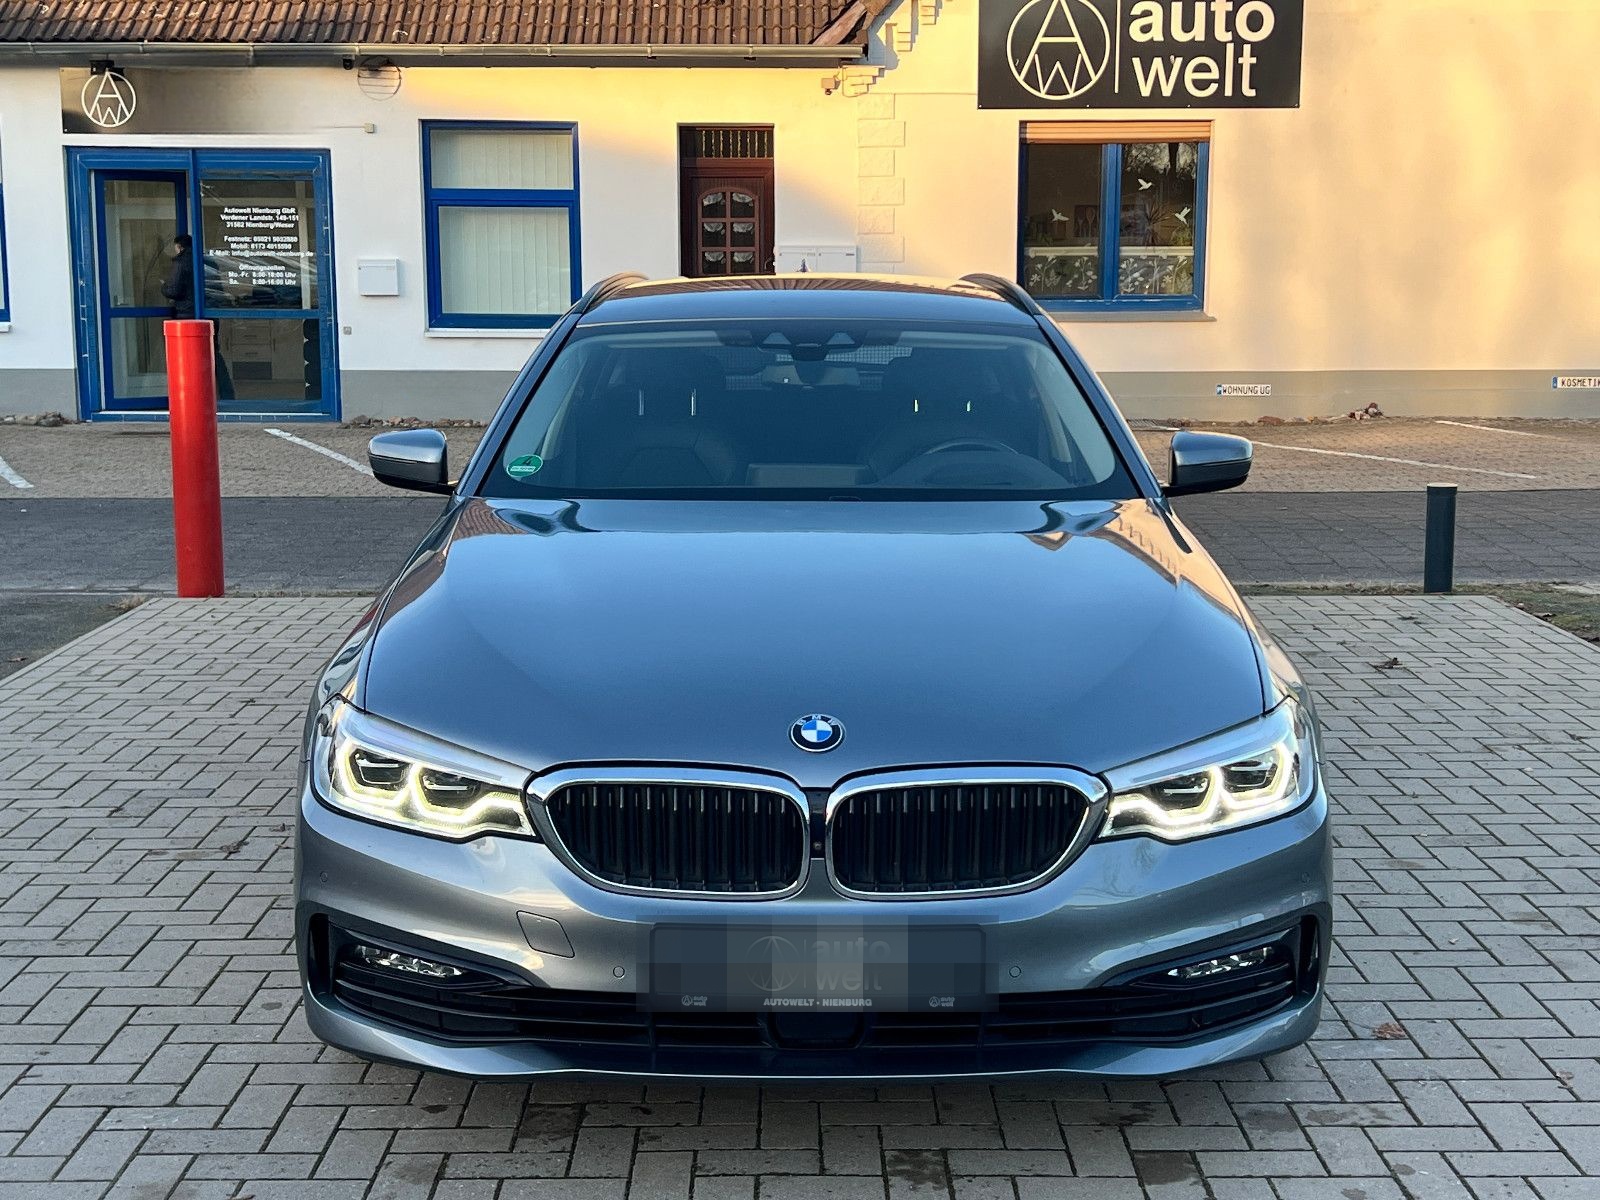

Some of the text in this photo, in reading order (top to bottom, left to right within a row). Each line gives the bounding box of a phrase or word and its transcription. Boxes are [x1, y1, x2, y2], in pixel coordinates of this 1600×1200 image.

[1128, 0, 1275, 42] auto
[1131, 42, 1257, 98] welt
[252, 207, 281, 215] Nienburg
[1222, 385, 1271, 395] WOHNUNG UG
[795, 714, 839, 726] BMW
[811, 936, 891, 960] auto
[763, 998, 873, 1007] AUTOWELT NIENBURG
